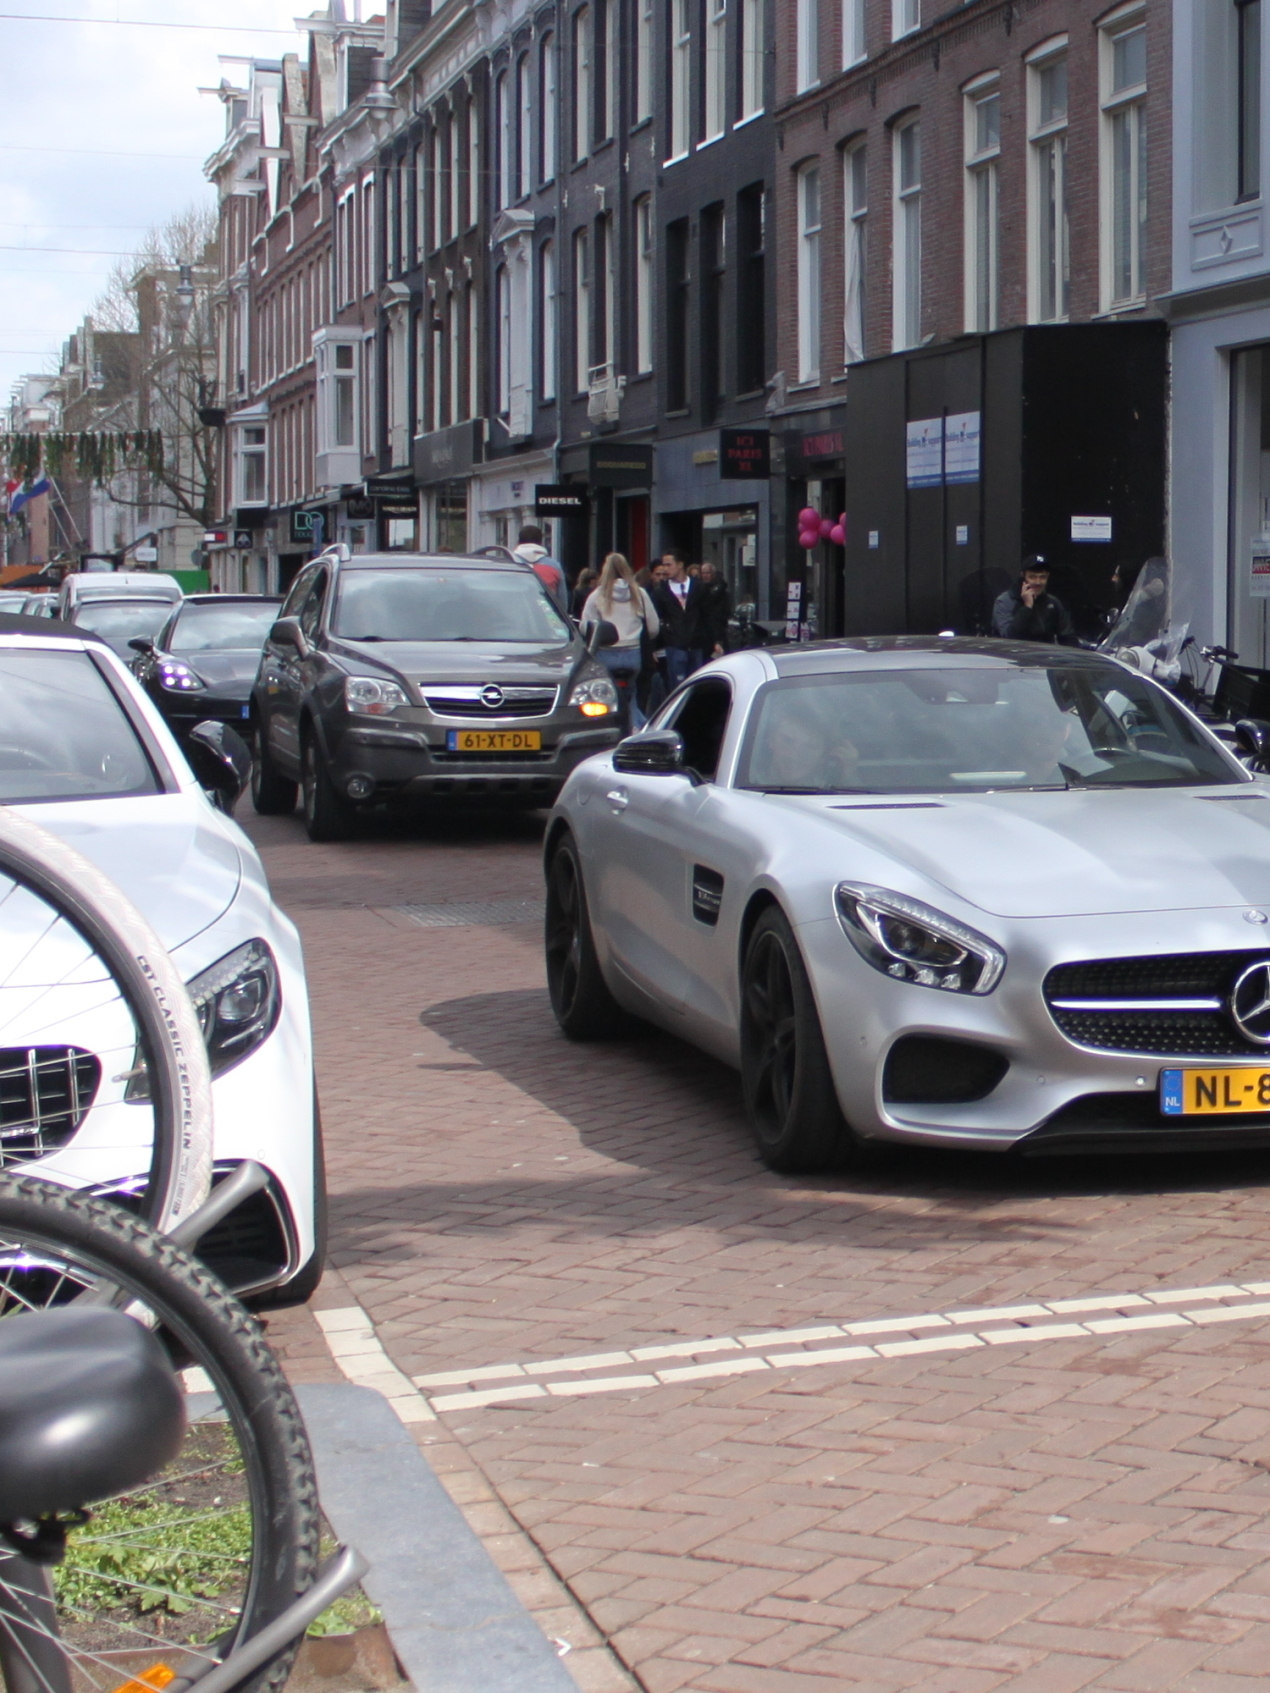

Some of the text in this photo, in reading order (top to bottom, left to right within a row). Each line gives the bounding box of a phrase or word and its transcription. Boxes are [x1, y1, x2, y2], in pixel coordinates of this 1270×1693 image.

[727, 449, 762, 459] PARIS
[539, 497, 581, 505] DIESEL
[464, 733, 532, 748] 61-XT-DL
[137, 955, 156, 980] CST
[153, 985, 184, 1059] CLASSIC
[178, 1062, 192, 1149] ZEPPELIN
[1165, 1096, 1181, 1107] NL
